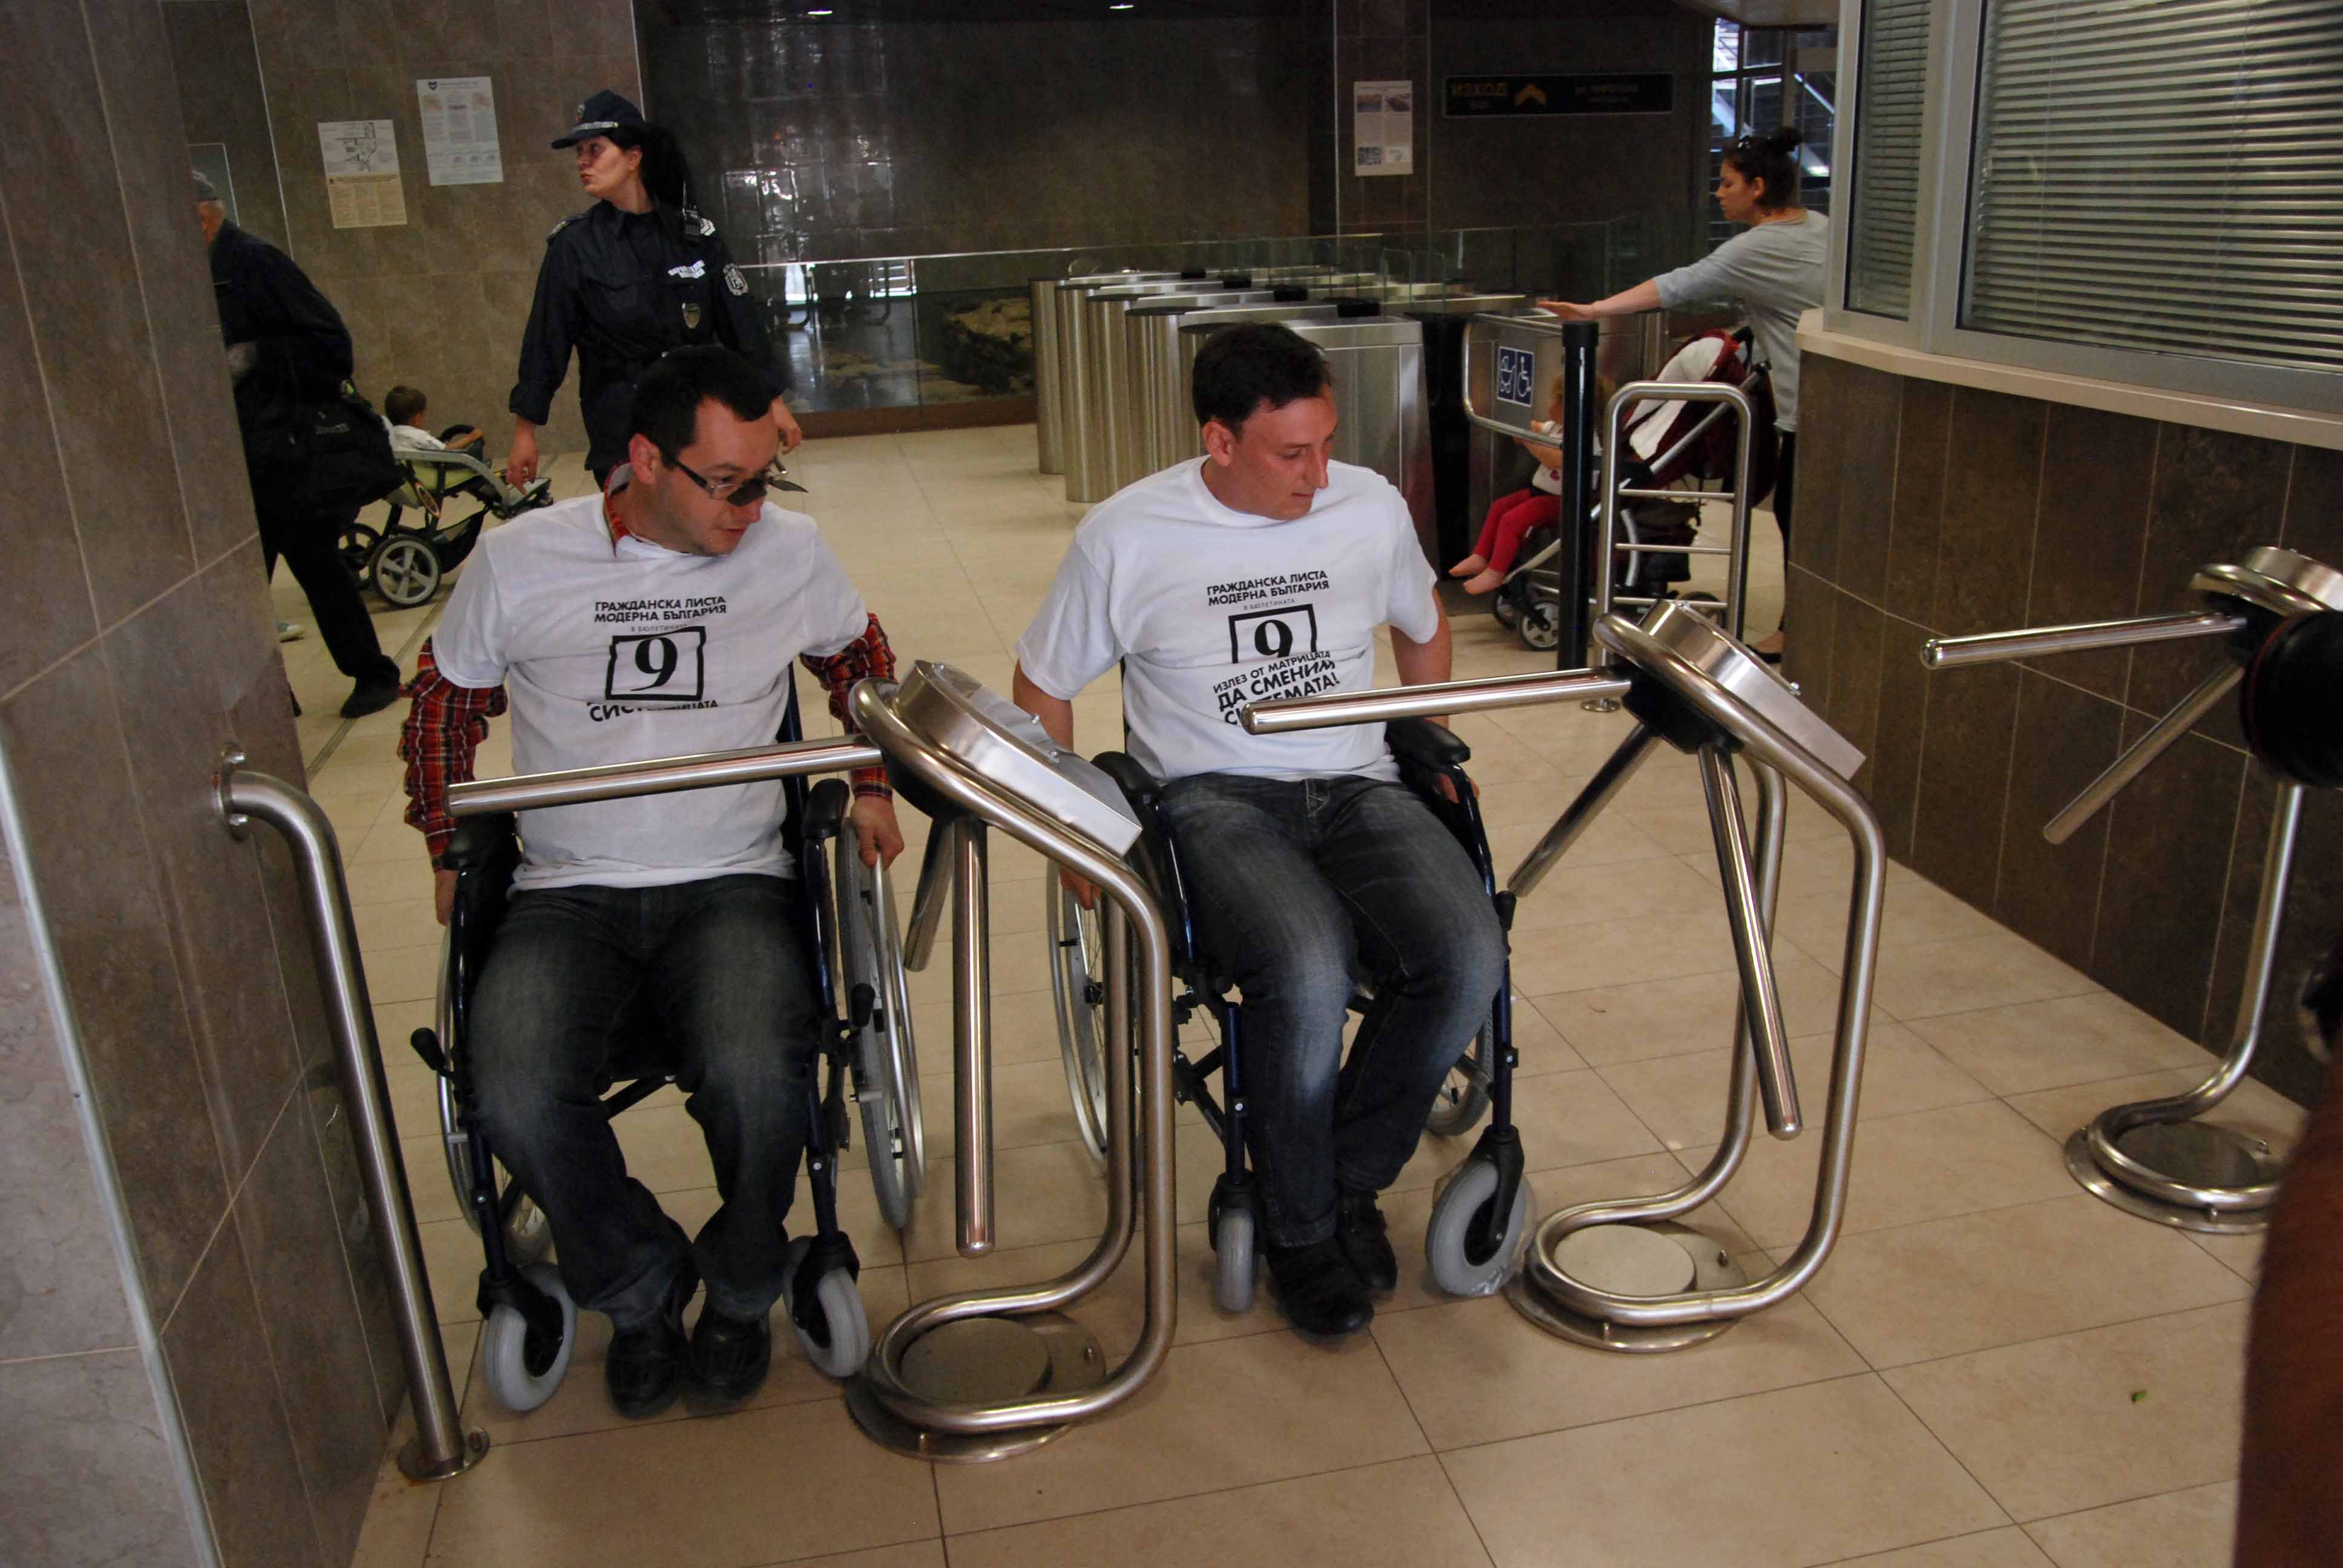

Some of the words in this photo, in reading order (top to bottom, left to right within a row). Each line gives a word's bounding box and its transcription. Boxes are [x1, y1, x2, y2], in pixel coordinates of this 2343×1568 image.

[1207, 577, 1286, 596] ГРАЖДАНСКА
[1290, 570, 1328, 583] ЛИСТА
[1208, 590, 1267, 606] МОДЕРНА
[1271, 581, 1329, 596] БЪЛГАРИЯ
[594, 611, 658, 623] МОДЕРНА
[663, 605, 727, 620] БЪЛГАРИЯ
[595, 599, 681, 612] ГРАЖДАНСКА
[685, 596, 726, 608] ЛИСТА
[631, 637, 678, 691] 9
[1213, 674, 1248, 693] ИЗЛЕЗ
[1250, 667, 1265, 679] ОТ
[1268, 651, 1331, 673] МАТРИЦАТА
[1217, 688, 1248, 712] ДА
[1250, 660, 1335, 696] СМЕНИМ
[1224, 672, 1340, 725] СМАТА!
